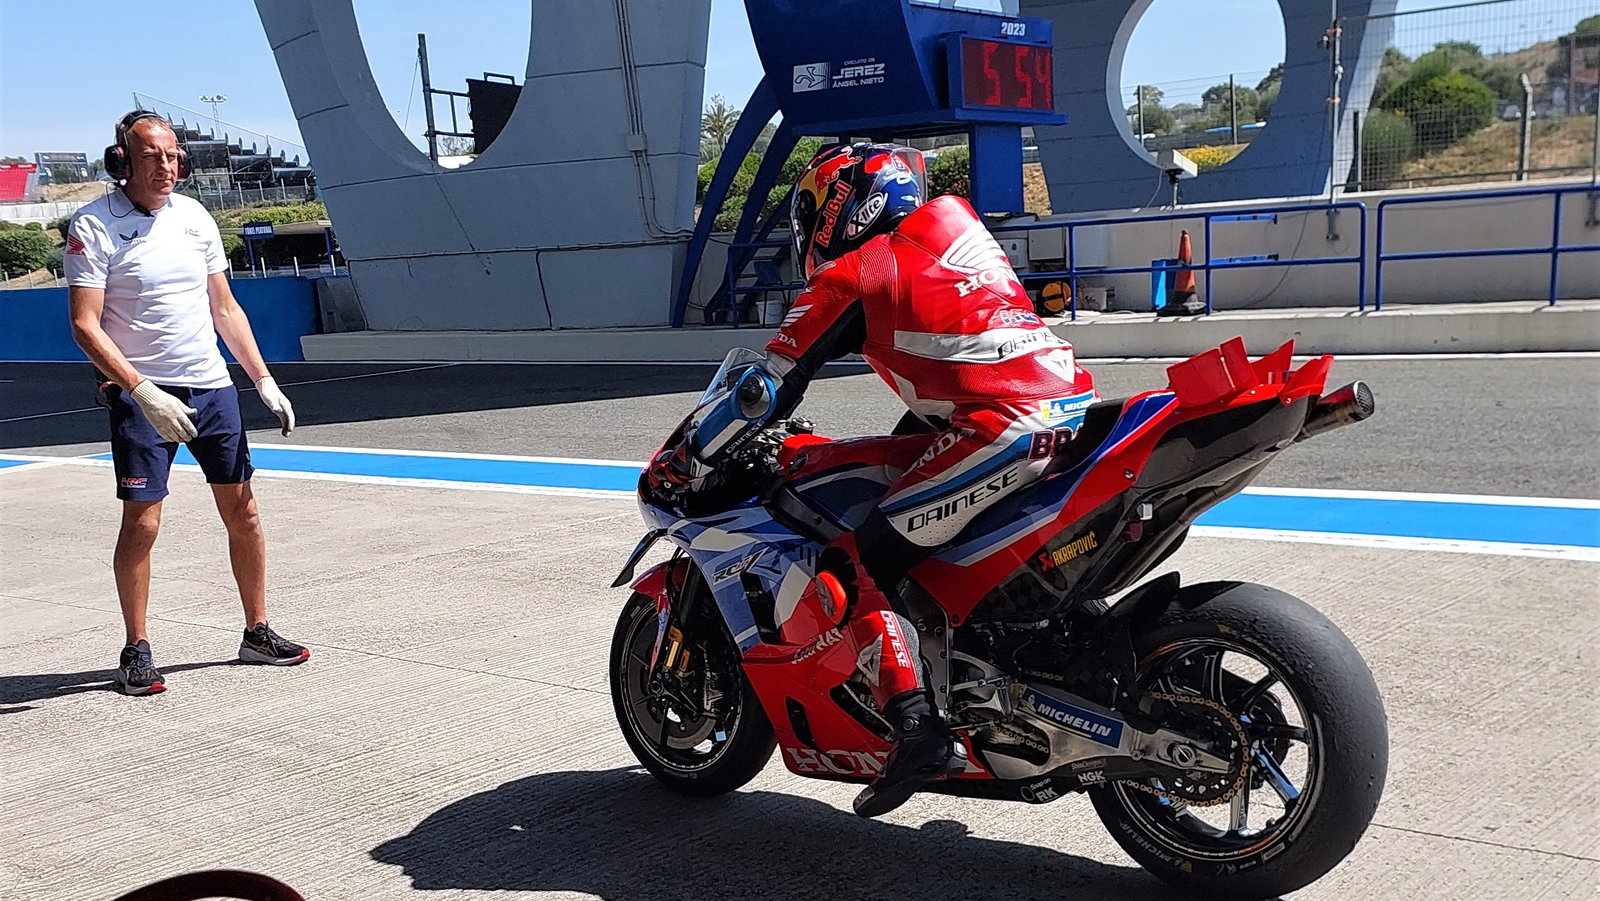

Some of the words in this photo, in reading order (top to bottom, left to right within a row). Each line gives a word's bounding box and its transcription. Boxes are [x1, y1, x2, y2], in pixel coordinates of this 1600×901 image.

[1001, 22, 1026, 36] 2023
[832, 63, 885, 79] JEREZ
[860, 77, 885, 85] NIETO
[815, 213, 834, 248] Red
[827, 180, 852, 217] Bull
[726, 419, 765, 453] DAINESE
[907, 466, 1018, 533] DAINESE
[1052, 531, 1098, 566] AKRAPOVIČ
[880, 610, 910, 668] DAINESE
[1037, 704, 1112, 737] MICHELIN
[1077, 770, 1106, 783] NGK
[1035, 787, 1059, 802] RK
